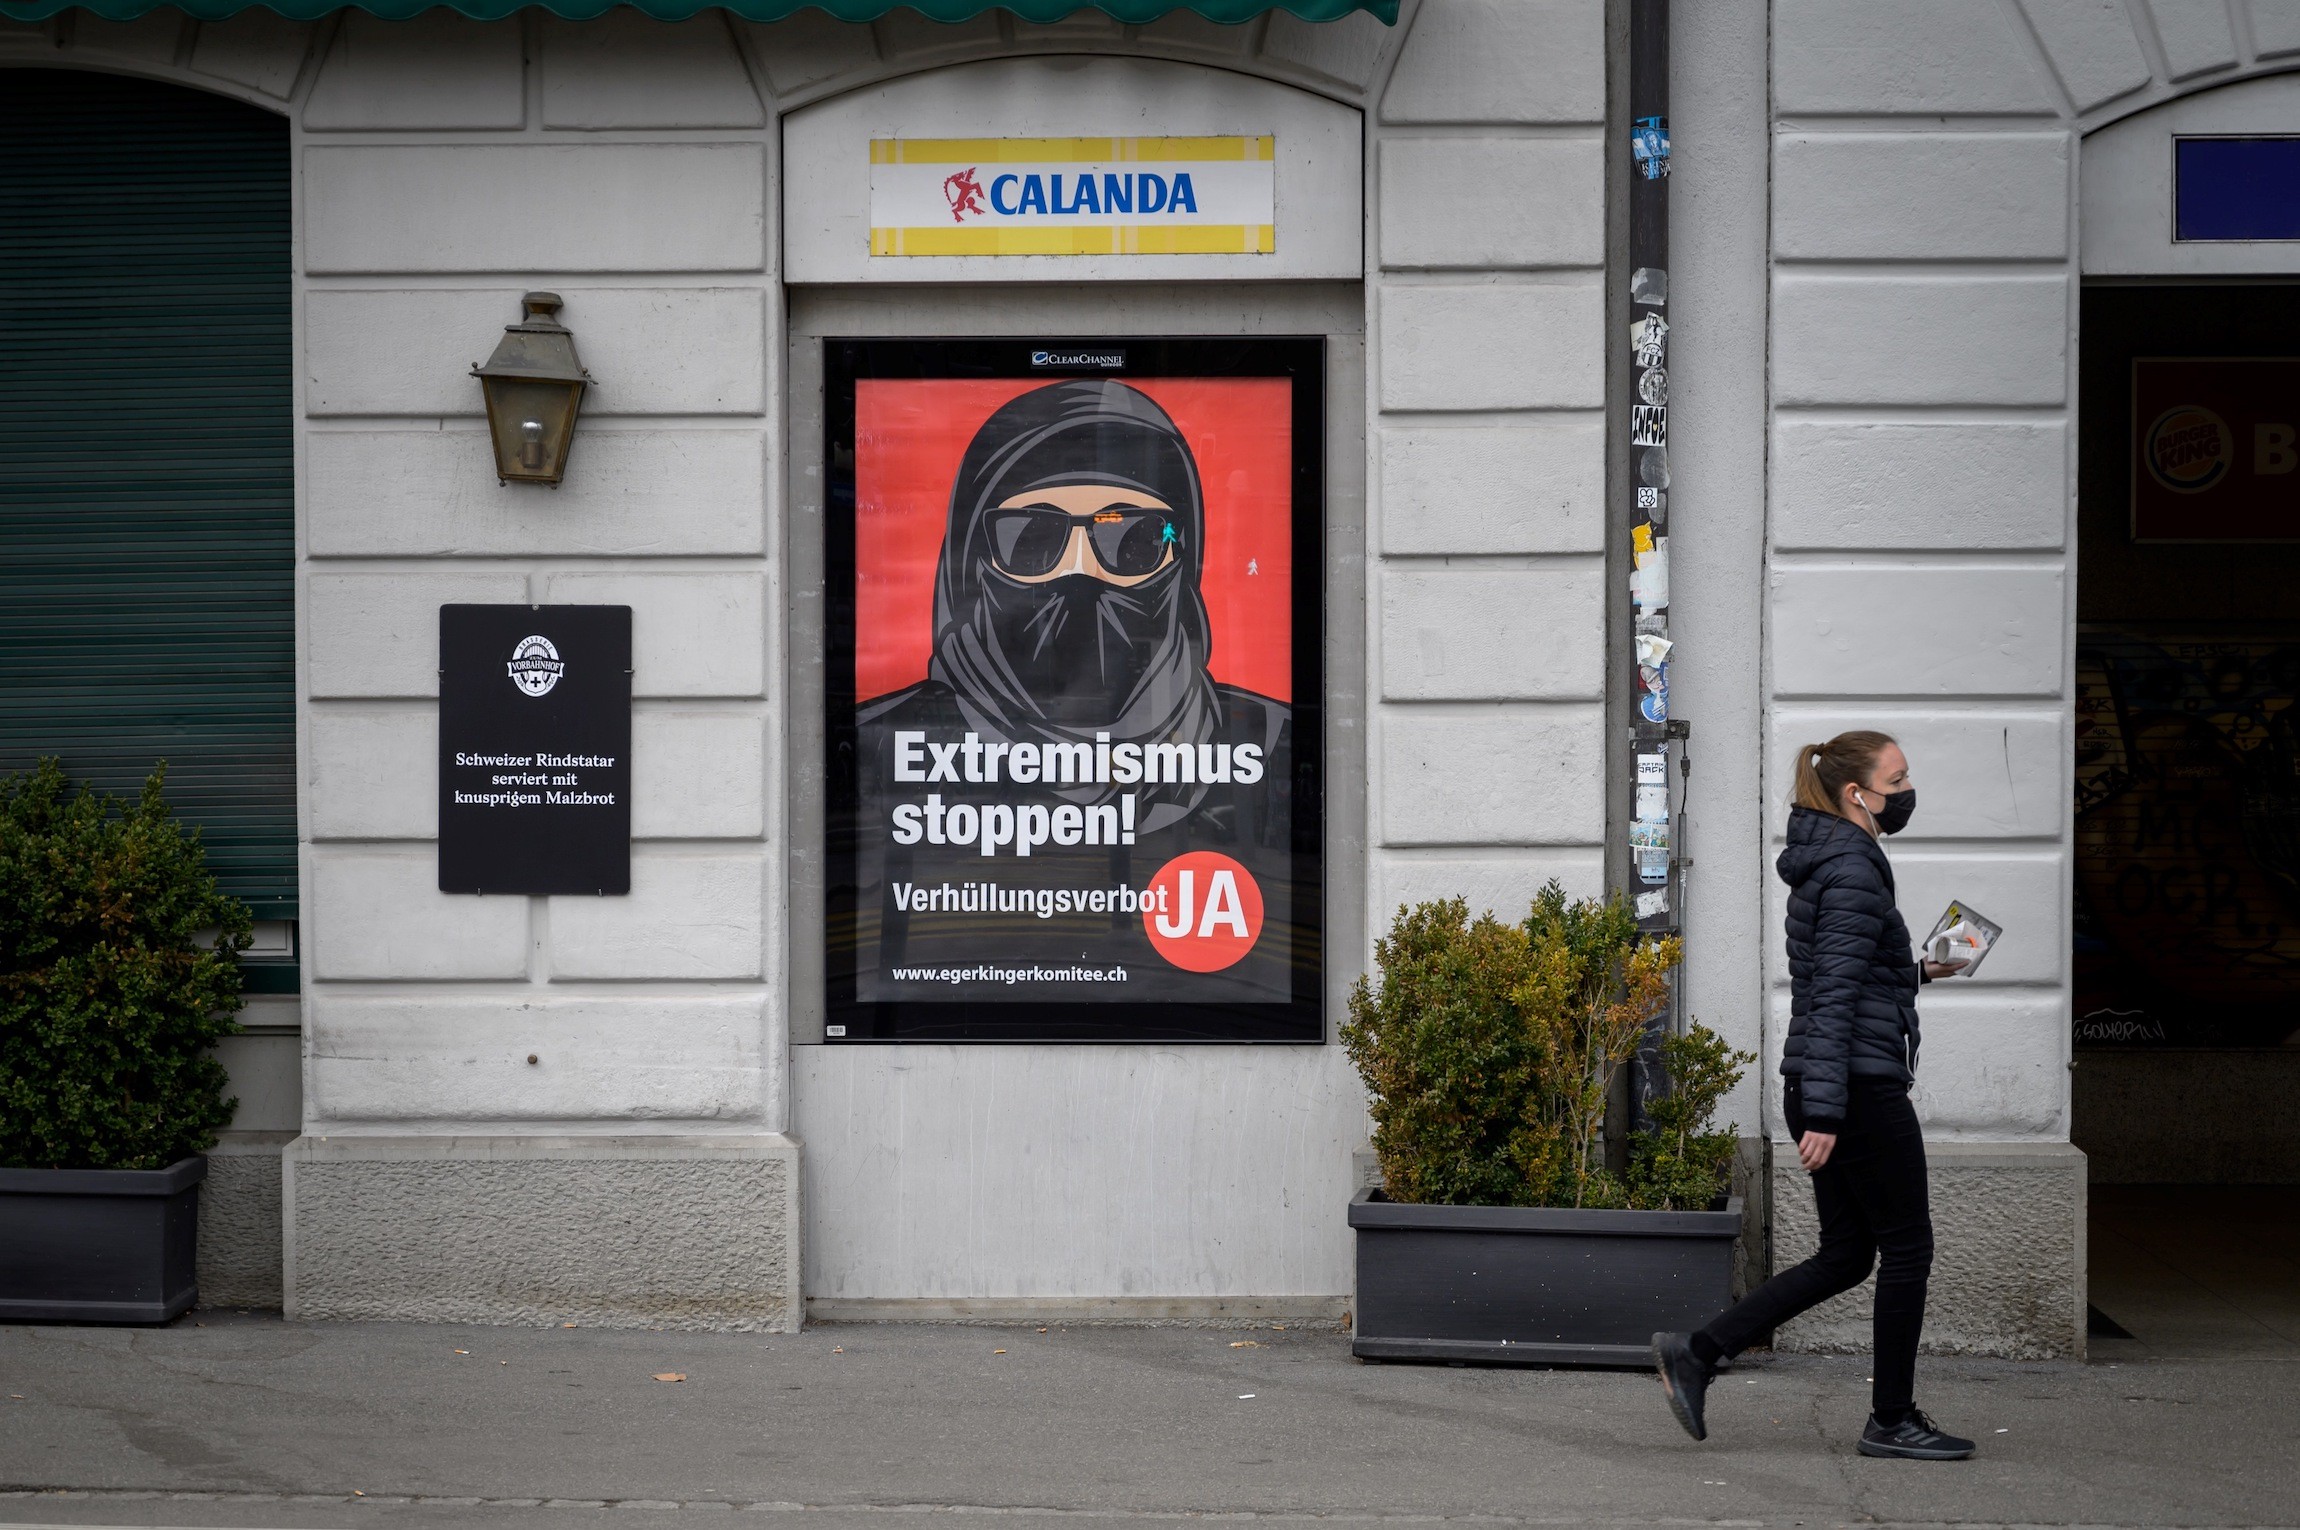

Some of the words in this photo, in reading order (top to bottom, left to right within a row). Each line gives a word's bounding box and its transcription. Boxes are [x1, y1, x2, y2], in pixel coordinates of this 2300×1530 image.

[990, 173, 1198, 216] CALANDA
[1646, 345, 1660, 355] FCZ
[2157, 423, 2219, 453] BURGER
[2159, 437, 2222, 471] KING
[518, 636, 554, 651] BRASSERIE
[511, 660, 561, 672] VORBAHNHOF
[455, 752, 532, 767] Schweizer
[536, 752, 615, 768] Rindstatar
[894, 731, 1264, 784] Extremismus
[491, 771, 549, 786] serviert
[552, 772, 578, 786] mit
[1638, 766, 1664, 774] JACK
[454, 789, 541, 808] knusprigem
[545, 790, 616, 806] Malzbrot
[892, 794, 1136, 856] stoppen!
[893, 881, 1169, 919] Verhüllungsverbot
[1155, 869, 1250, 939] JA
[892, 964, 1128, 985] www.egerkingerkomitee.ch
